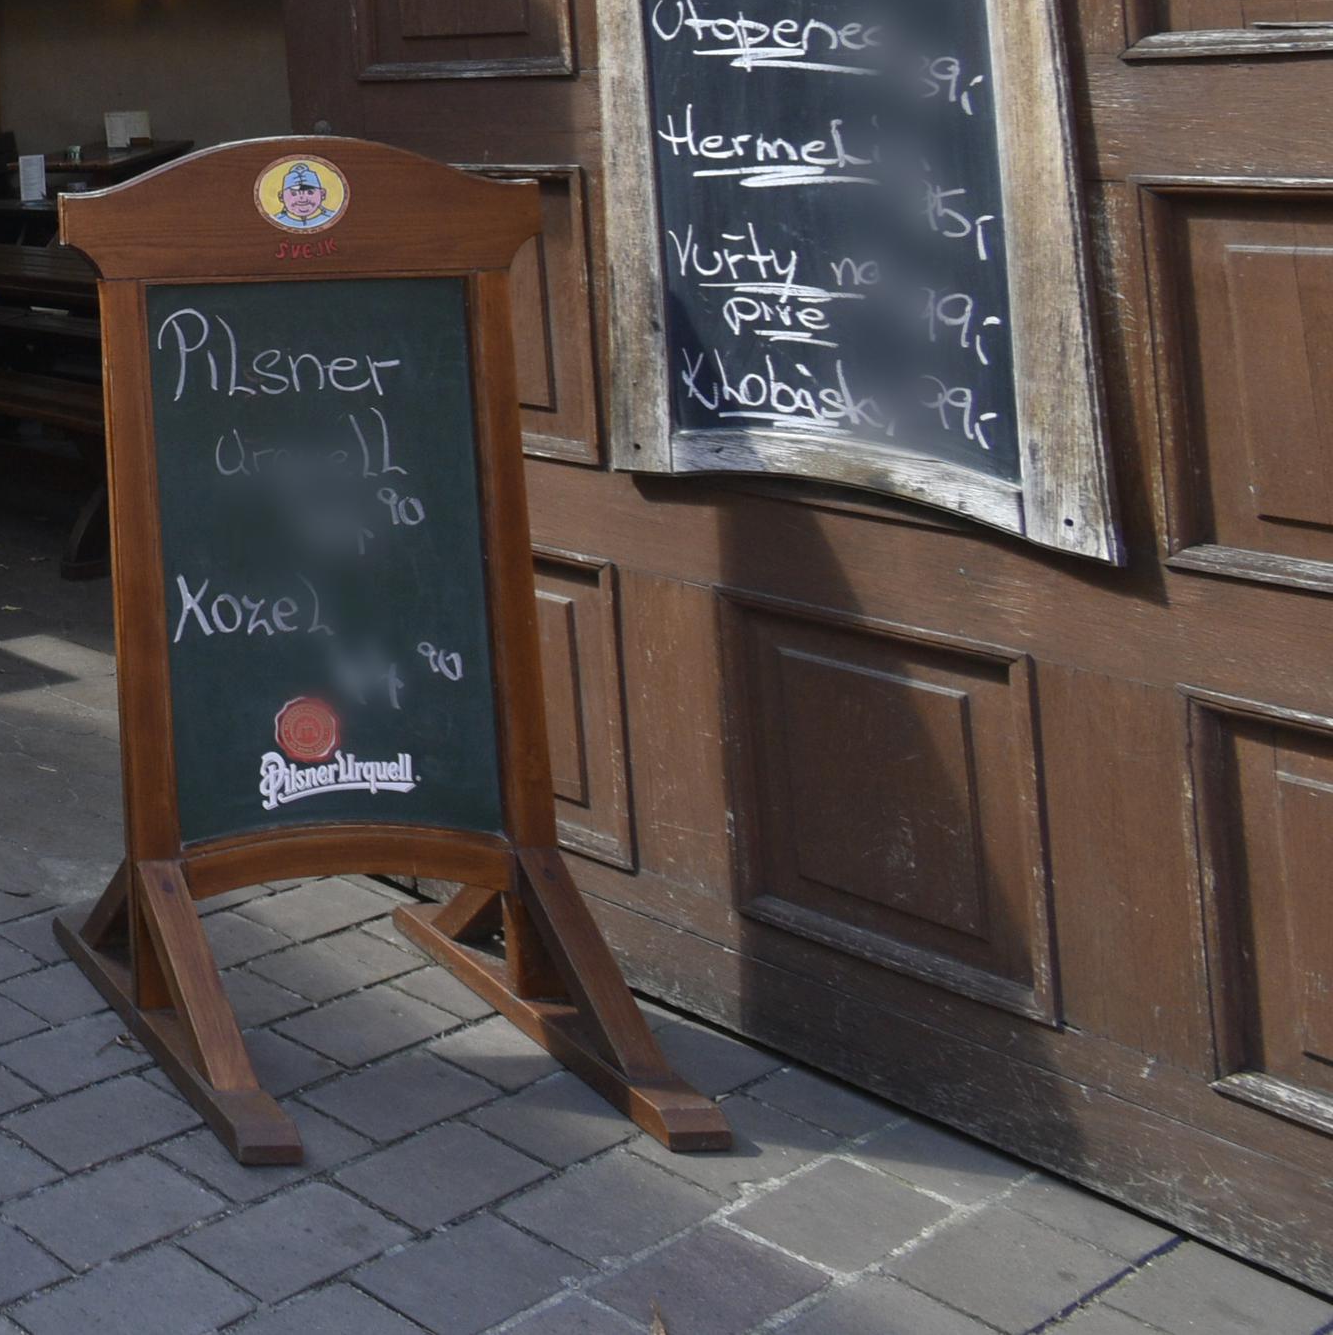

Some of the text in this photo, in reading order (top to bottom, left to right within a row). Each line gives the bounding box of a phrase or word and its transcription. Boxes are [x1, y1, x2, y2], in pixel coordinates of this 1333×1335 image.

[214, 406, 410, 478] Urell
[173, 572, 335, 645] Kozel
[259, 749, 415, 812] Pilsner Urquell
